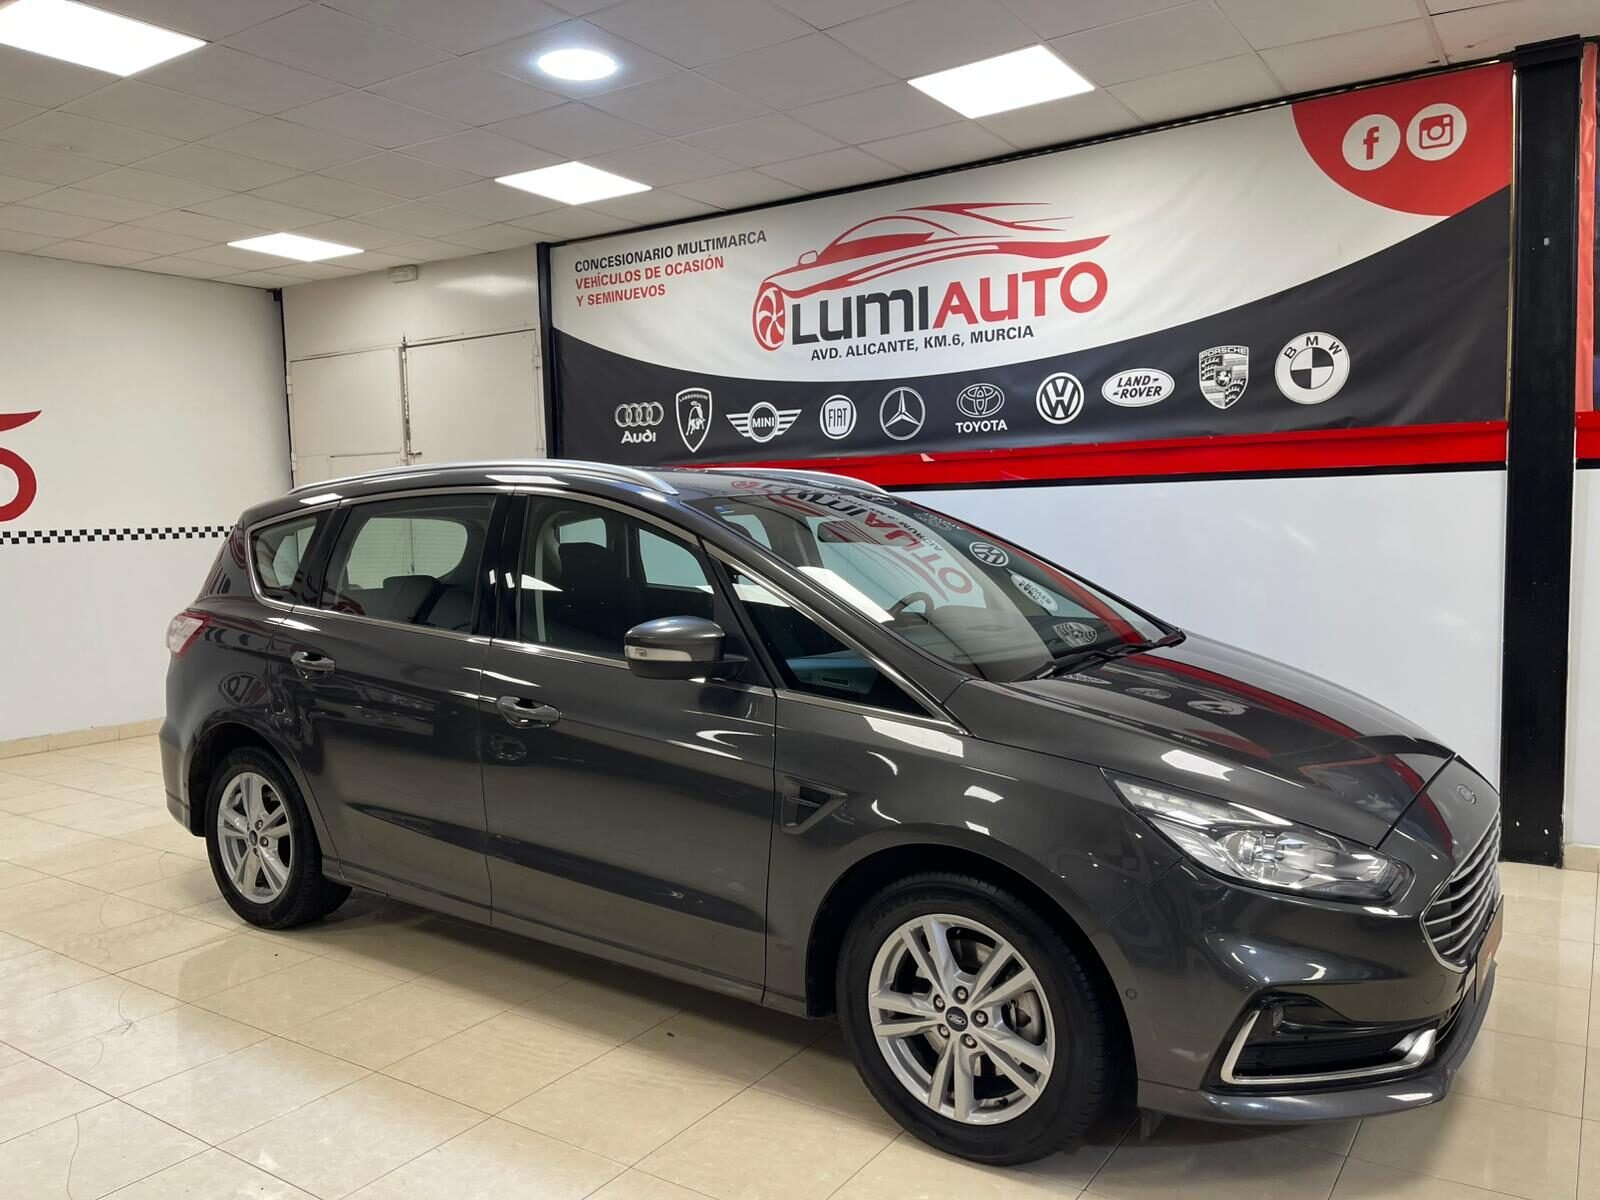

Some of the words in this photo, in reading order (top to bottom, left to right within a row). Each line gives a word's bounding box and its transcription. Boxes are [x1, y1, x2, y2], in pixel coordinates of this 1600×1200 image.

[574, 246, 673, 273] CONCESIONARIO
[677, 229, 767, 256] MULTIMARCA
[575, 269, 641, 290] VEHÍCULOS
[645, 266, 661, 280] DE
[664, 255, 724, 276] OCASIÓN
[576, 295, 583, 307] Y
[587, 284, 666, 306] SEMINUEVOS
[811, 346, 842, 361] AVD.
[845, 338, 919, 358] ALICANTE,
[970, 325, 1034, 344] MURCIA
[751, 416, 775, 429] MINI
[828, 407, 848, 428] FIAT
[955, 419, 1008, 434] TOYOTA
[620, 429, 656, 445] Audi
